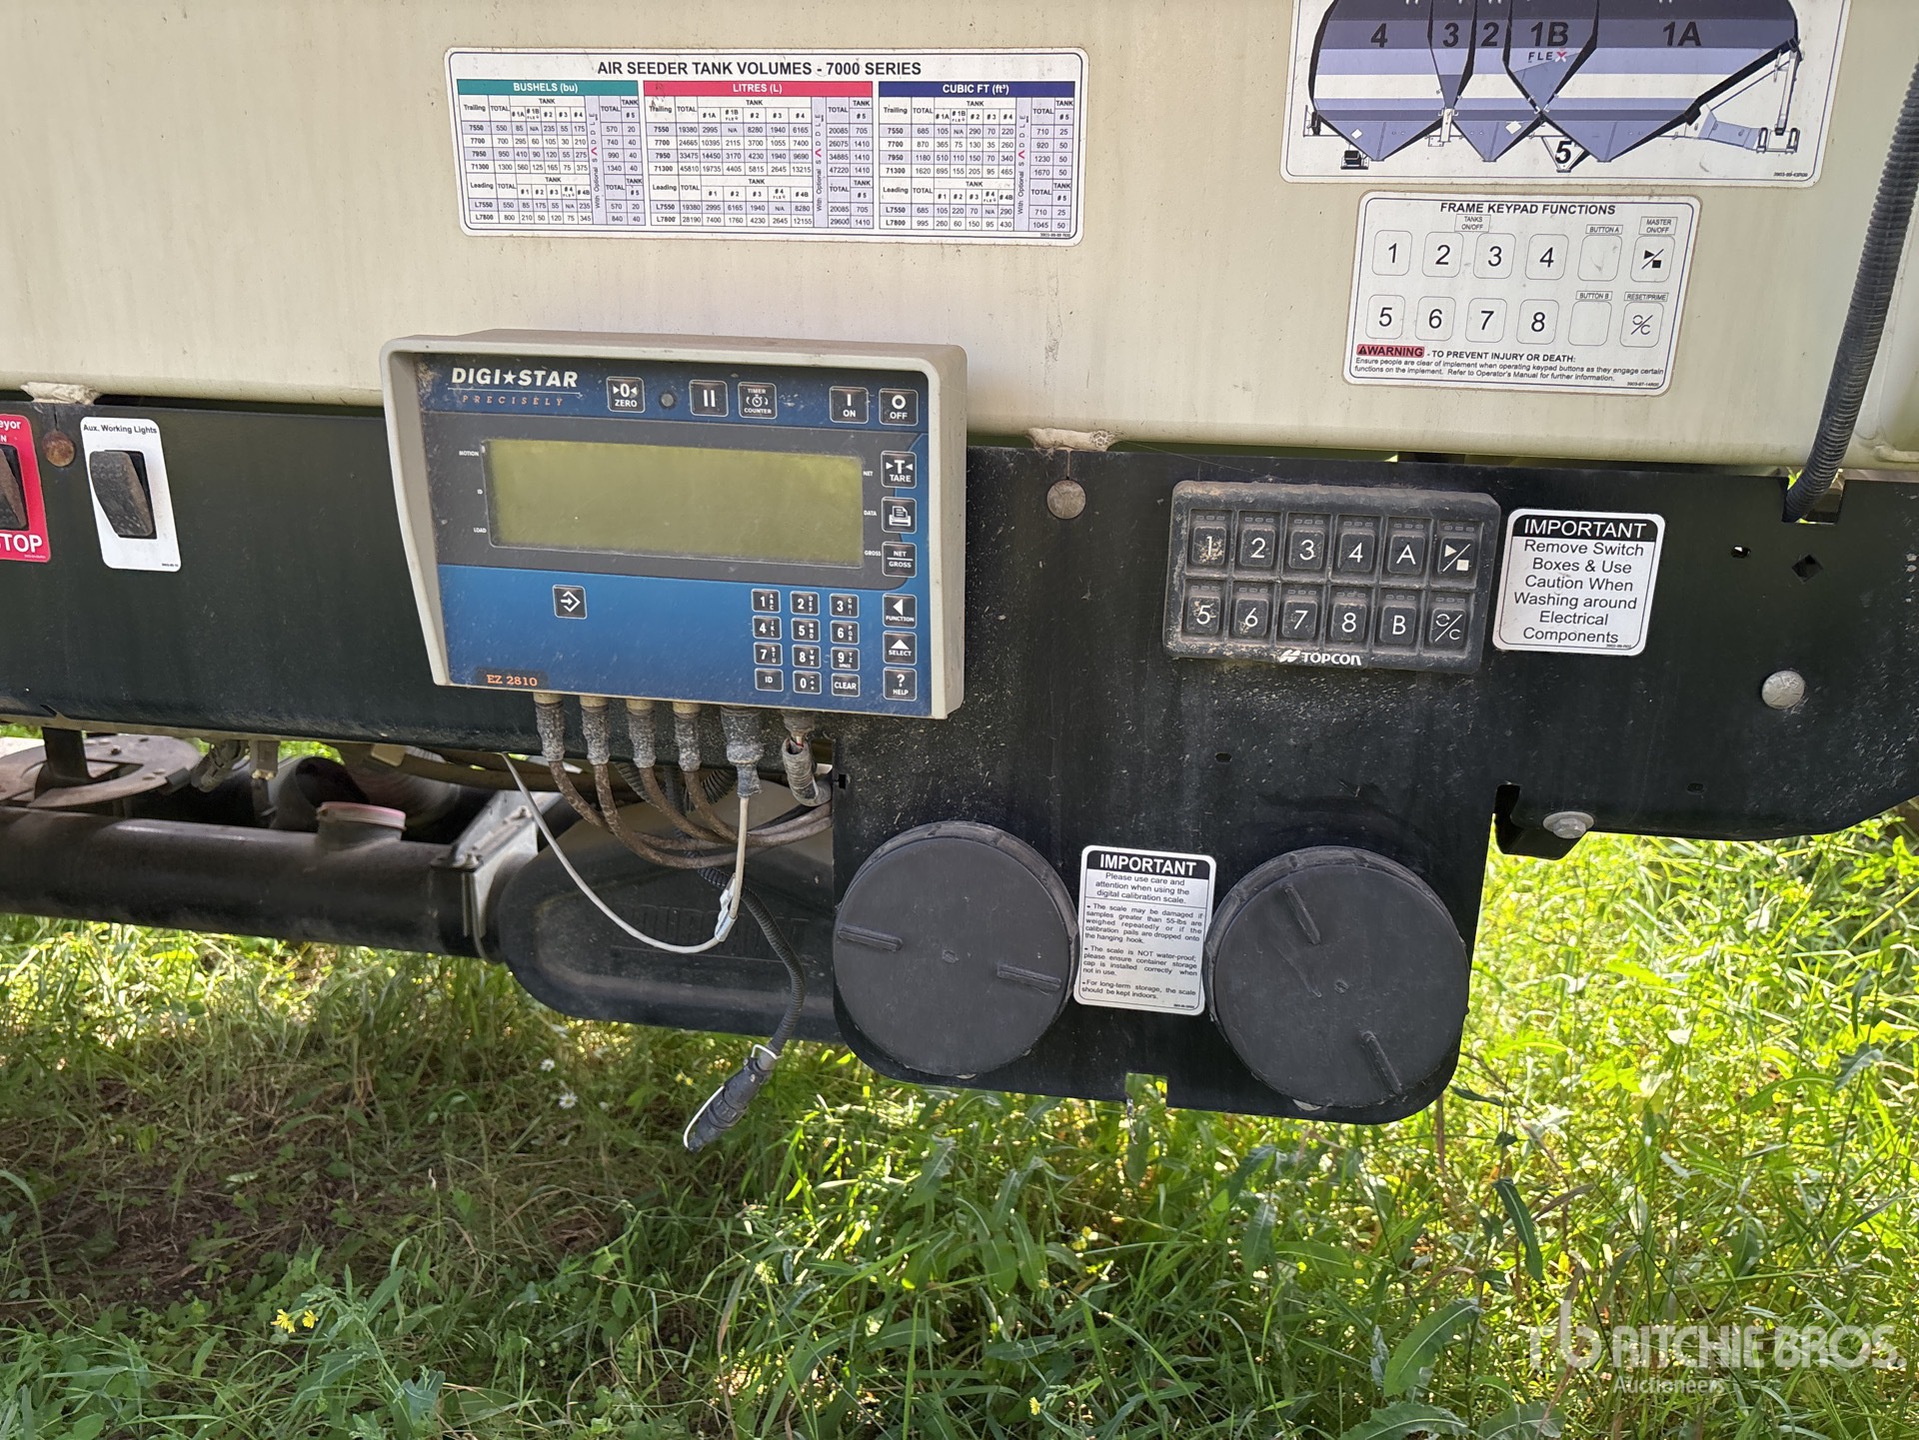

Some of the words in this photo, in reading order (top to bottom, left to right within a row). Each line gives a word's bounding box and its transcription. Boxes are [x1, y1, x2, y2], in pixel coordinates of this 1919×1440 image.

[1370, 23, 1388, 47] 4
[1442, 24, 1459, 47] 3
[1481, 24, 1499, 47] 2
[1530, 22, 1570, 47] 1B
[1662, 23, 1700, 47] 1A
[1528, 51, 1567, 63] FLEX
[598, 62, 622, 74] AIR
[627, 62, 688, 74] SEEDER
[692, 62, 731, 75] TANK
[735, 62, 812, 75] VOLUMES
[826, 62, 860, 75] 7000
[865, 62, 921, 75] SERIES
[513, 82, 557, 92] BUSHELS
[560, 82, 578, 93] (bu)
[733, 83, 767, 93] LITRES
[770, 83, 782, 94] (L)
[942, 84, 973, 93] CUBIC
[977, 84, 989, 93] FT
[992, 83, 1009, 95] (ft³)
[464, 104, 486, 113] Trailing
[1556, 141, 1572, 164] 5
[470, 182, 493, 190] Leading
[1440, 203, 1484, 213] FRAME
[1488, 204, 1538, 214] KEYPAD
[1542, 205, 1616, 215] FUNCTIONS
[1646, 218, 1671, 226] MASTER
[1388, 243, 1397, 263] 1
[1436, 245, 1450, 265] 2
[1488, 246, 1502, 266] 3
[1540, 248, 1554, 267] 4
[1627, 293, 1666, 301] RESET/PRIME
[1379, 307, 1392, 326] 5
[1429, 309, 1442, 329] 6
[1481, 311, 1494, 330] 7
[1531, 312, 1545, 332] 8
[1367, 346, 1423, 357] WARNING
[1446, 352, 1488, 360] PREVENT
[1491, 353, 1524, 361] INJURY
[1380, 359, 1402, 367] people
[1443, 361, 1476, 369] implement
[1499, 363, 1531, 371] operating
[1533, 364, 1556, 372] keypad
[1596, 366, 1611, 374] they
[463, 396, 563, 406] PRECISELY
[614, 399, 637, 407] ZERO
[843, 410, 856, 418] ON
[83, 424, 100, 432] Aux.
[101, 425, 132, 434] Working
[134, 426, 157, 434] Lights
[890, 474, 911, 483] TARE
[1524, 519, 1646, 538] IMPORTANT
[0, 534, 42, 552] TOP
[1524, 539, 1587, 554] Remove
[1594, 543, 1644, 556] Switch
[1206, 536, 1212, 556] 1
[1252, 538, 1265, 558] 2
[1300, 540, 1314, 560] 3
[1350, 543, 1363, 562] 4
[1396, 545, 1416, 565] A
[1533, 558, 1580, 571] Boxes
[1585, 560, 1595, 572] &
[1602, 560, 1632, 573] Use
[1525, 575, 1583, 589] Caution
[1589, 578, 1633, 591] When
[760, 597, 765, 606] 1
[798, 599, 804, 609] 2
[837, 601, 843, 611] 3
[1514, 592, 1578, 609] Washing
[1584, 598, 1637, 609] around
[1196, 606, 1210, 624] 5
[1246, 608, 1258, 627] 6
[1294, 611, 1308, 630] 7
[1342, 613, 1356, 632] 8
[1393, 615, 1406, 634] B
[1540, 611, 1608, 625] Electrical
[759, 623, 766, 633] 4
[799, 625, 805, 635] 5
[837, 628, 844, 638] 6
[1523, 627, 1618, 643] Components
[761, 650, 767, 659] 7
[800, 652, 806, 662] 8
[838, 652, 844, 662] 9
[1302, 653, 1361, 666] TOPCON
[487, 674, 503, 684] EZ
[507, 676, 537, 687] 2810
[800, 678, 806, 688] 0
[1100, 854, 1196, 875] IMPORTANT
[1106, 872, 1132, 881] Please
[1170, 878, 1185, 886] and
[1095, 881, 1128, 889] attention
[1131, 884, 1151, 892] when
[1154, 886, 1175, 895] using
[1177, 887, 1189, 895] the
[1097, 890, 1119, 898] digital
[1121, 892, 1161, 901] calibration
[1164, 896, 1186, 904] scale.
